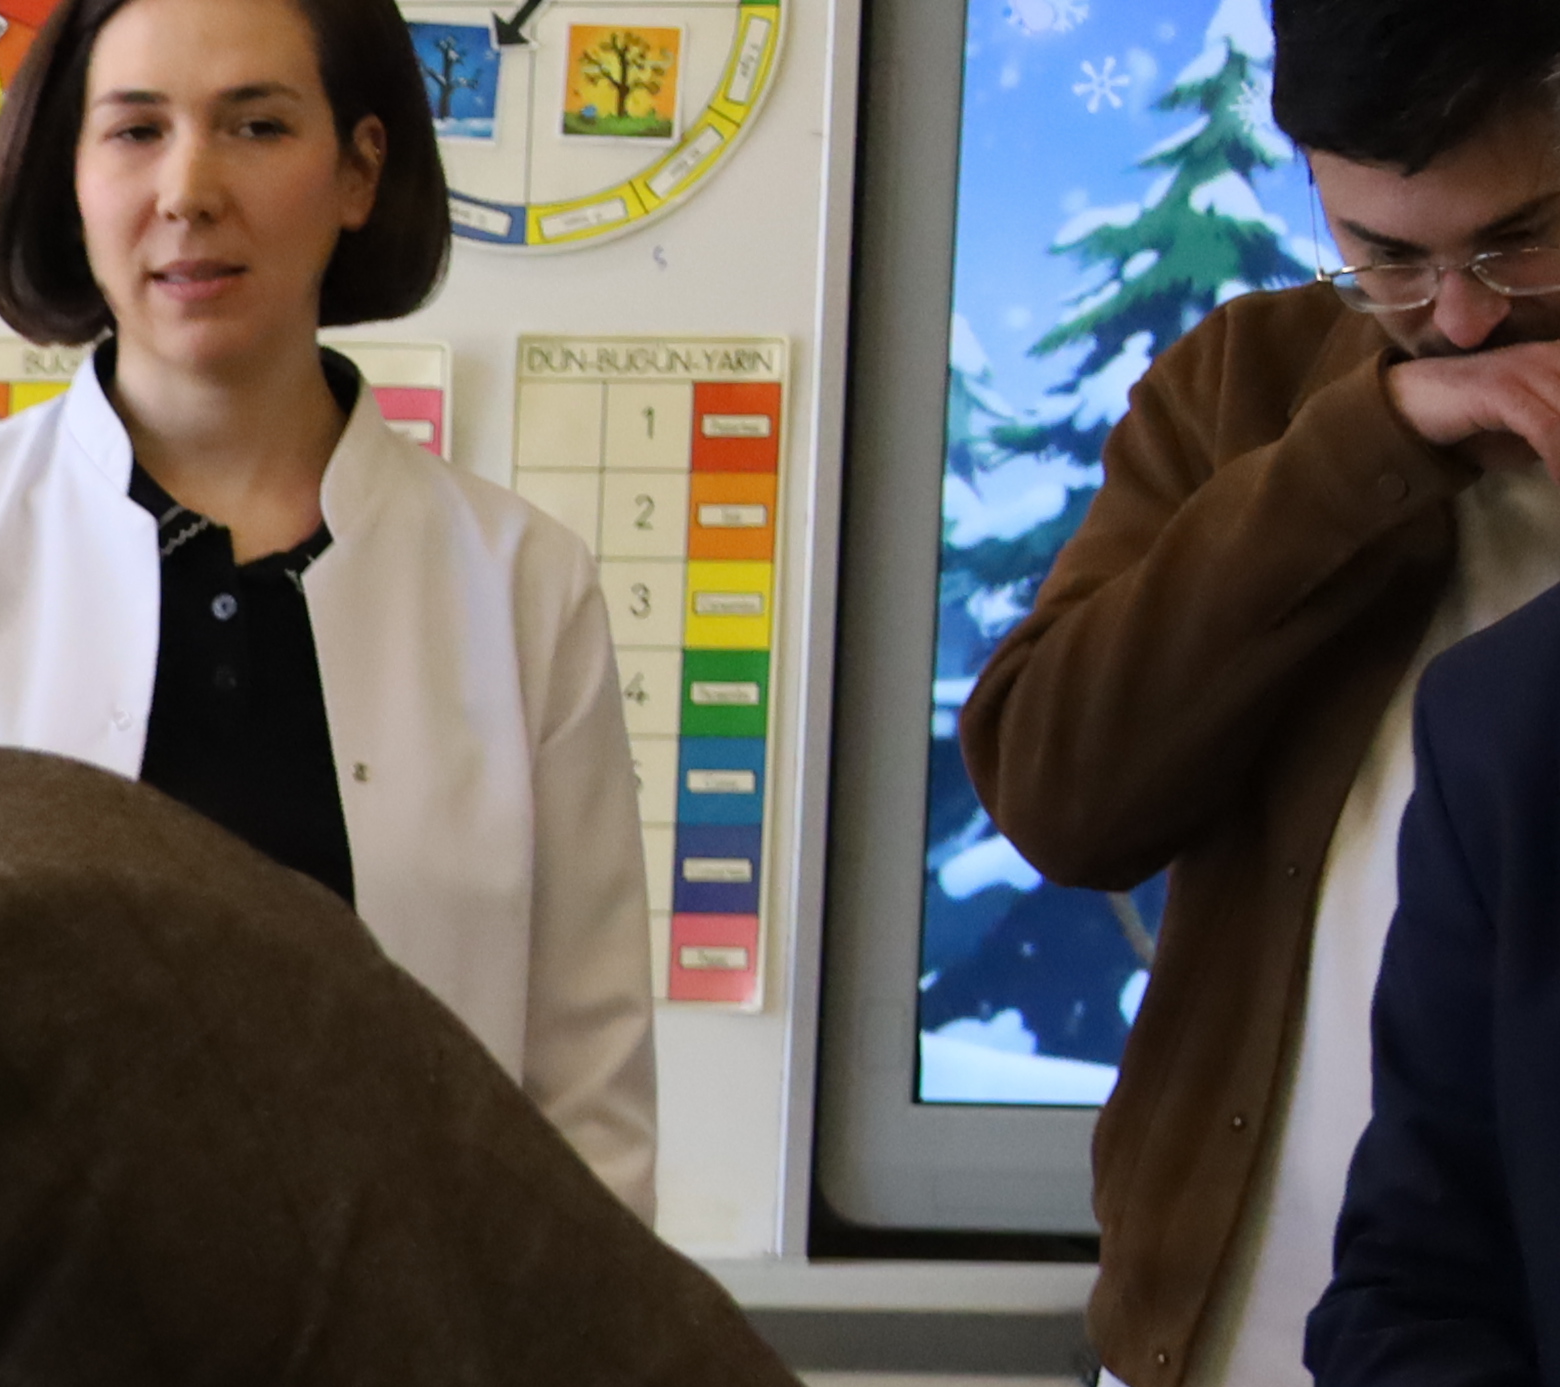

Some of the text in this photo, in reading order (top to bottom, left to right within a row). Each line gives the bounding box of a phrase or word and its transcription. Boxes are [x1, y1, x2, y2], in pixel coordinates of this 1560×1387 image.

[643, 406, 655, 439] 1
[634, 494, 655, 531] 2
[630, 581, 653, 619] 3
[623, 671, 650, 706] 4
